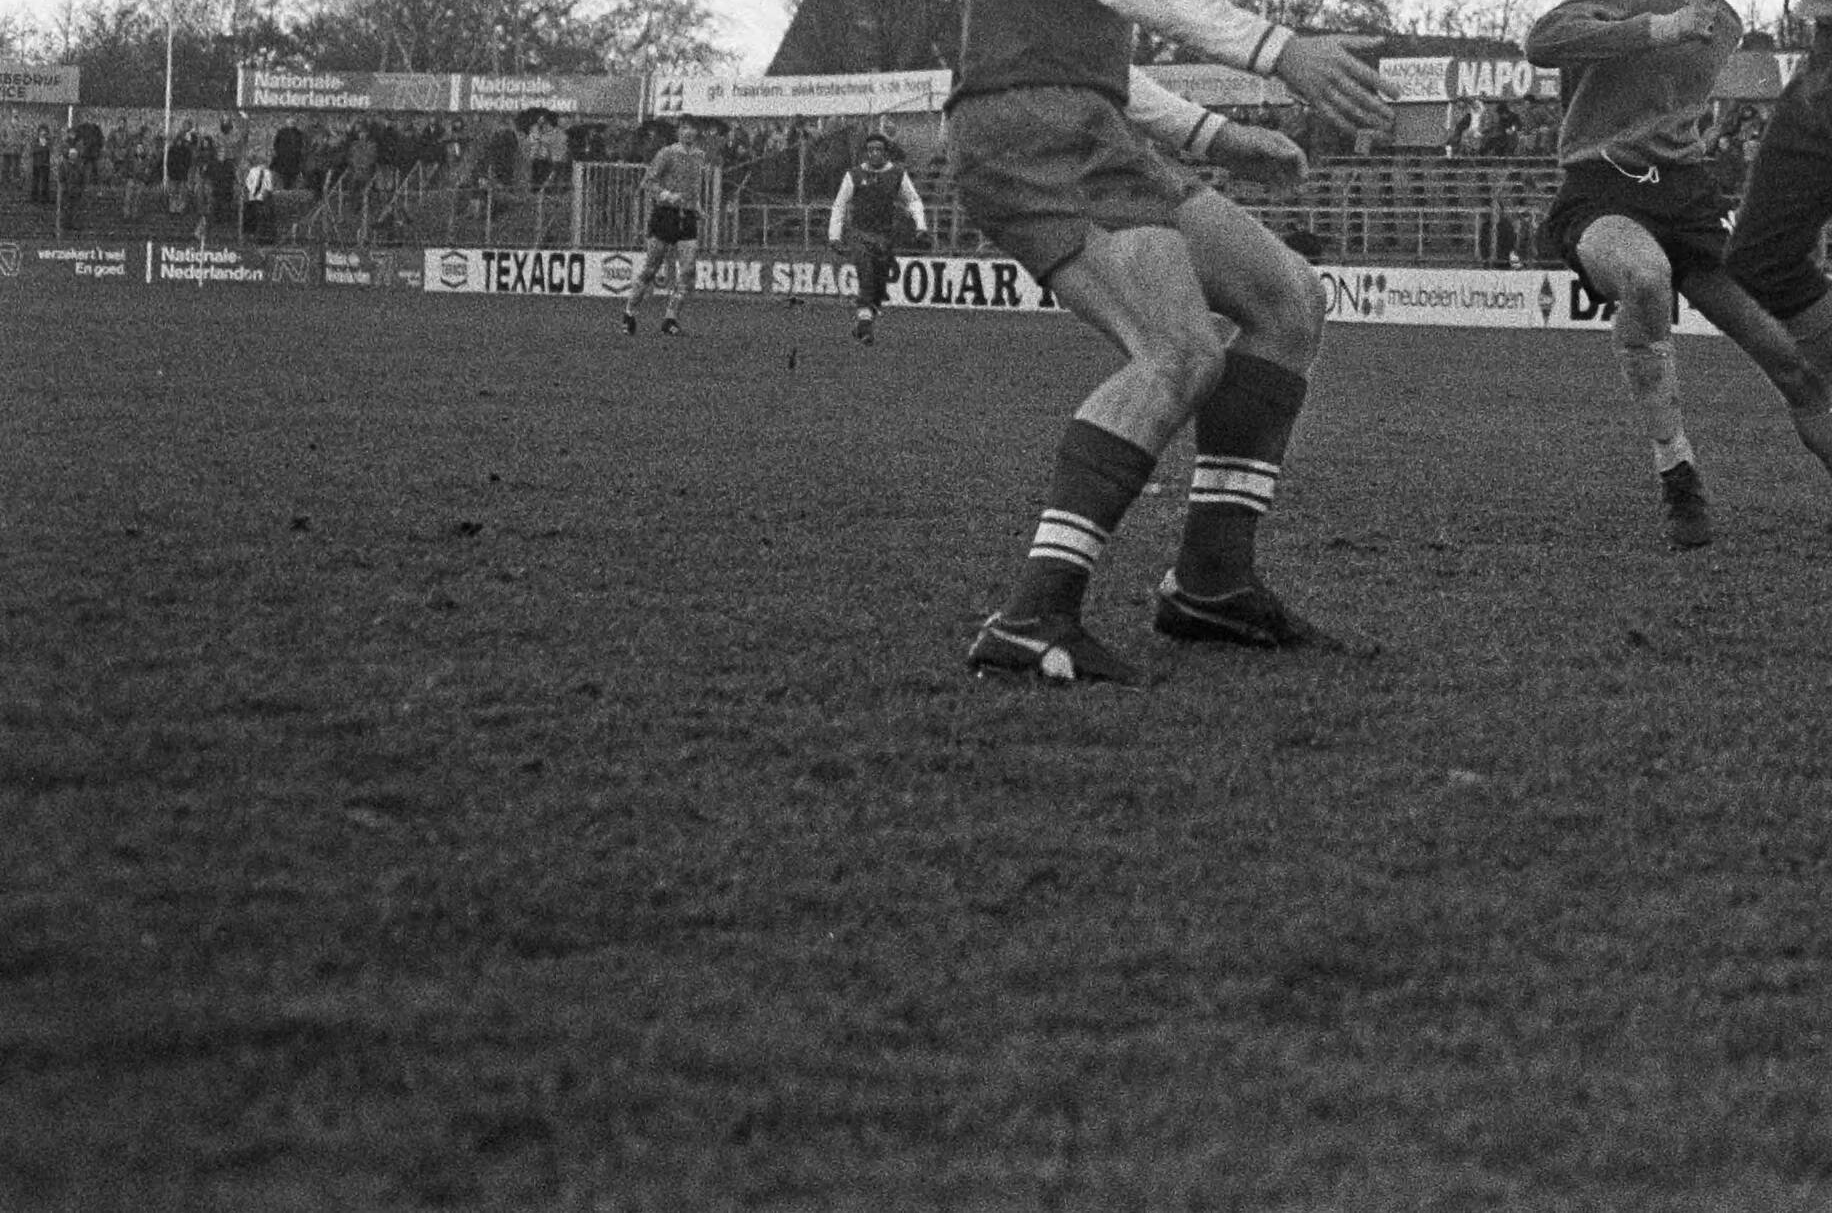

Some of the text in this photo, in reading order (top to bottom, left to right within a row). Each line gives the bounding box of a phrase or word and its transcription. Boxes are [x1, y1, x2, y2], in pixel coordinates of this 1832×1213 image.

[161, 263, 264, 282] Nederlanden
[482, 251, 585, 294] TEXACO
[771, 261, 860, 296] SHAG
